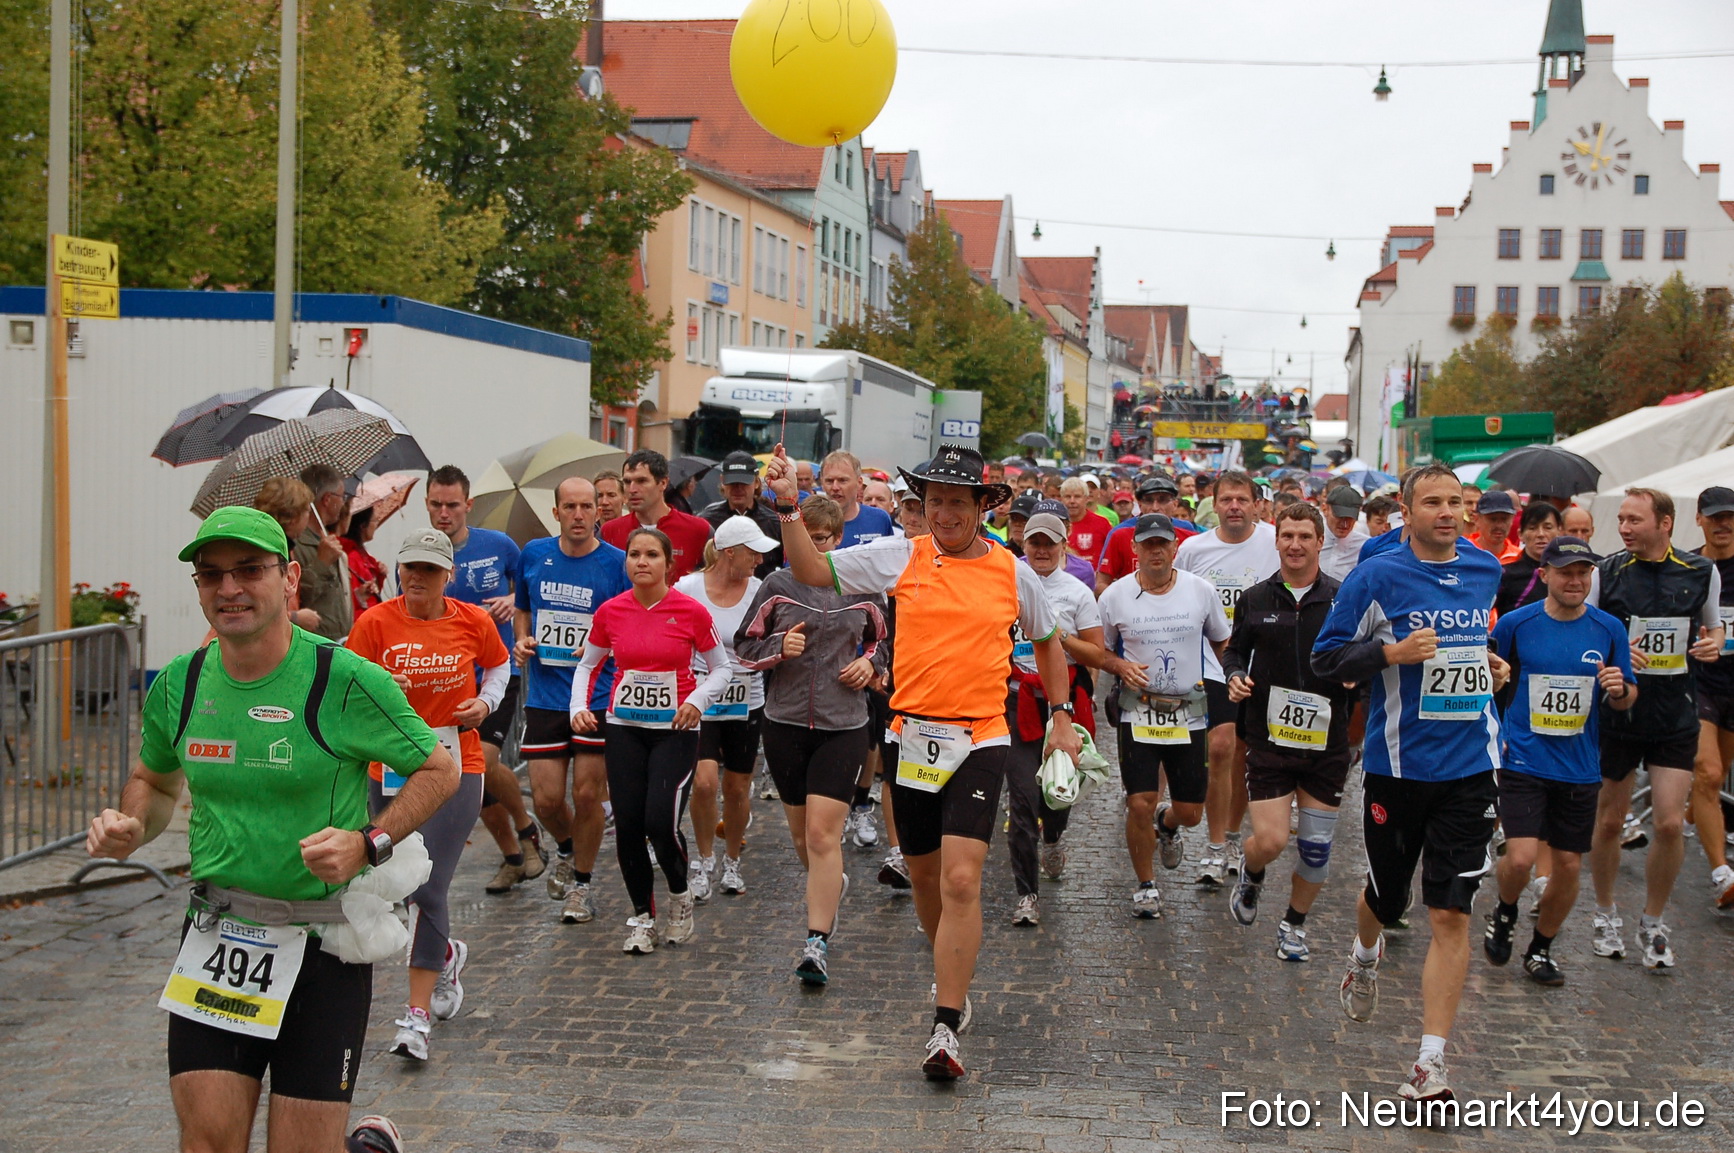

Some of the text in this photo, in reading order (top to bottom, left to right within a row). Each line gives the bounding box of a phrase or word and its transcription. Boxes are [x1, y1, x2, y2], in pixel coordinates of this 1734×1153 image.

[65, 241, 100, 258] Kinder-
[731, 388, 792, 403] BOCK
[1189, 425, 1228, 435] START
[540, 581, 593, 600] HUBER
[1216, 589, 1242, 606] 30
[551, 594, 589, 606] TECHNOLOGY
[1144, 612, 1189, 624] Johannesbad
[1408, 609, 1489, 630] SYSCAD
[541, 625, 588, 647] 2167
[1638, 633, 1675, 653] 481
[395, 653, 461, 668] Fischer
[1447, 651, 1476, 660] BOCK
[402, 665, 457, 675] AUTOMOBILE
[1430, 666, 1488, 693] 2796
[620, 685, 671, 707] 2955
[1444, 699, 1478, 709] Robert
[1541, 692, 1581, 713] 484
[630, 711, 659, 720] Verena
[1143, 710, 1178, 726] 164
[1278, 704, 1318, 729] 487
[1543, 717, 1577, 727] Michael
[1148, 728, 1173, 737] Werner
[1278, 729, 1312, 742] Andreas
[189, 743, 232, 758] OBI
[926, 740, 940, 765] 9
[917, 769, 940, 782] Bernd
[221, 921, 267, 940] BOCK
[202, 943, 275, 993] 494
[193, 1005, 247, 1026] Stephan
